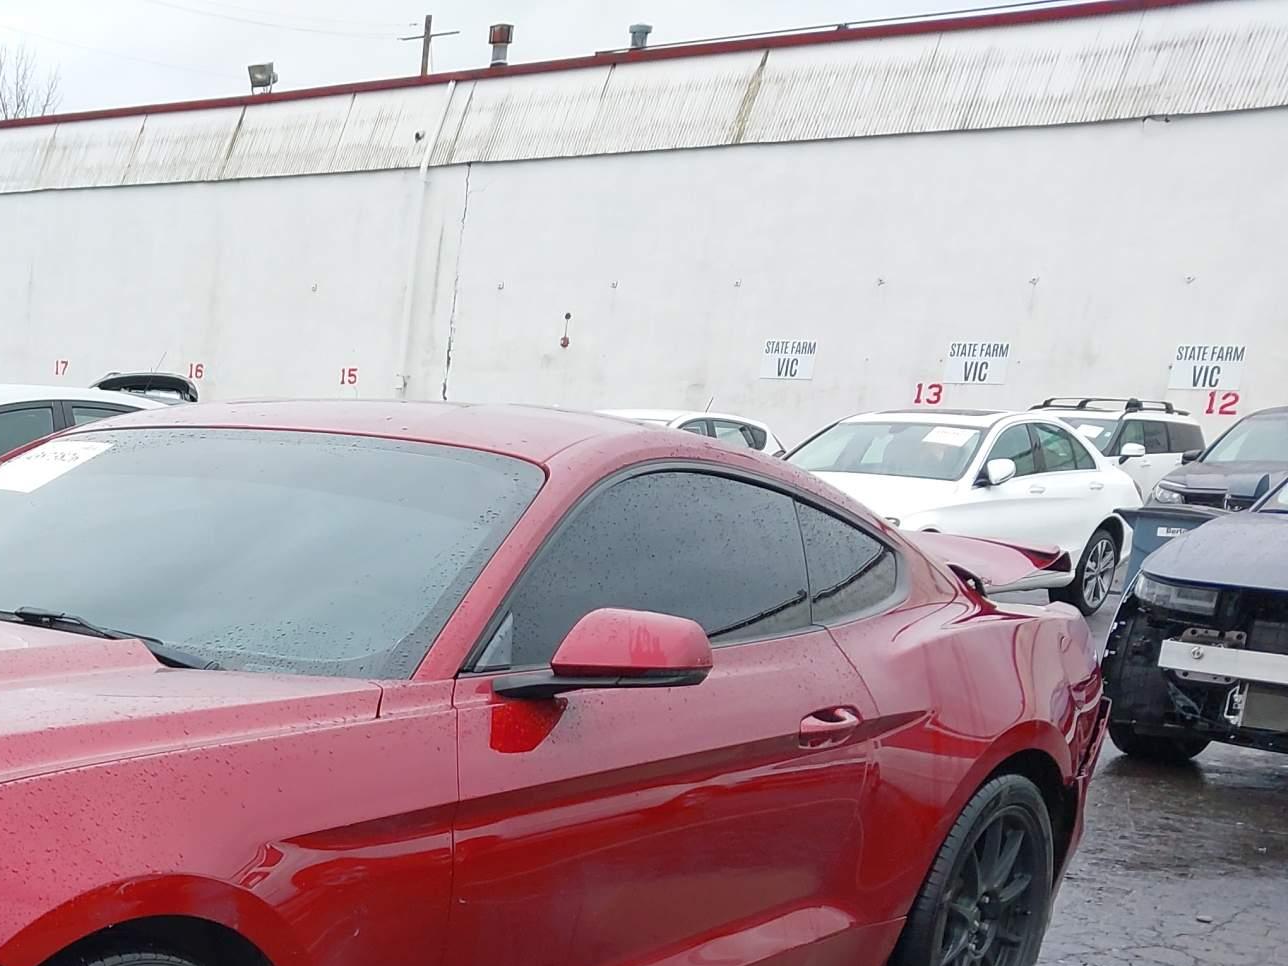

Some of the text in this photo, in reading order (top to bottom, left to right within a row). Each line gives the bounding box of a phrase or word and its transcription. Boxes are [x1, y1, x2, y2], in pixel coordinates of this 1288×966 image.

[764, 340, 817, 355] STATE FARM
[949, 343, 1010, 358] STATE FARM
[1176, 345, 1246, 362] STATE FARM
[54, 359, 69, 376] 17
[188, 363, 205, 379] 16
[340, 367, 358, 385] 15
[776, 357, 799, 378] VIC
[963, 361, 989, 382] VIC
[1192, 365, 1221, 388] VIC
[913, 383, 944, 404] 13
[1205, 391, 1240, 415] 12
